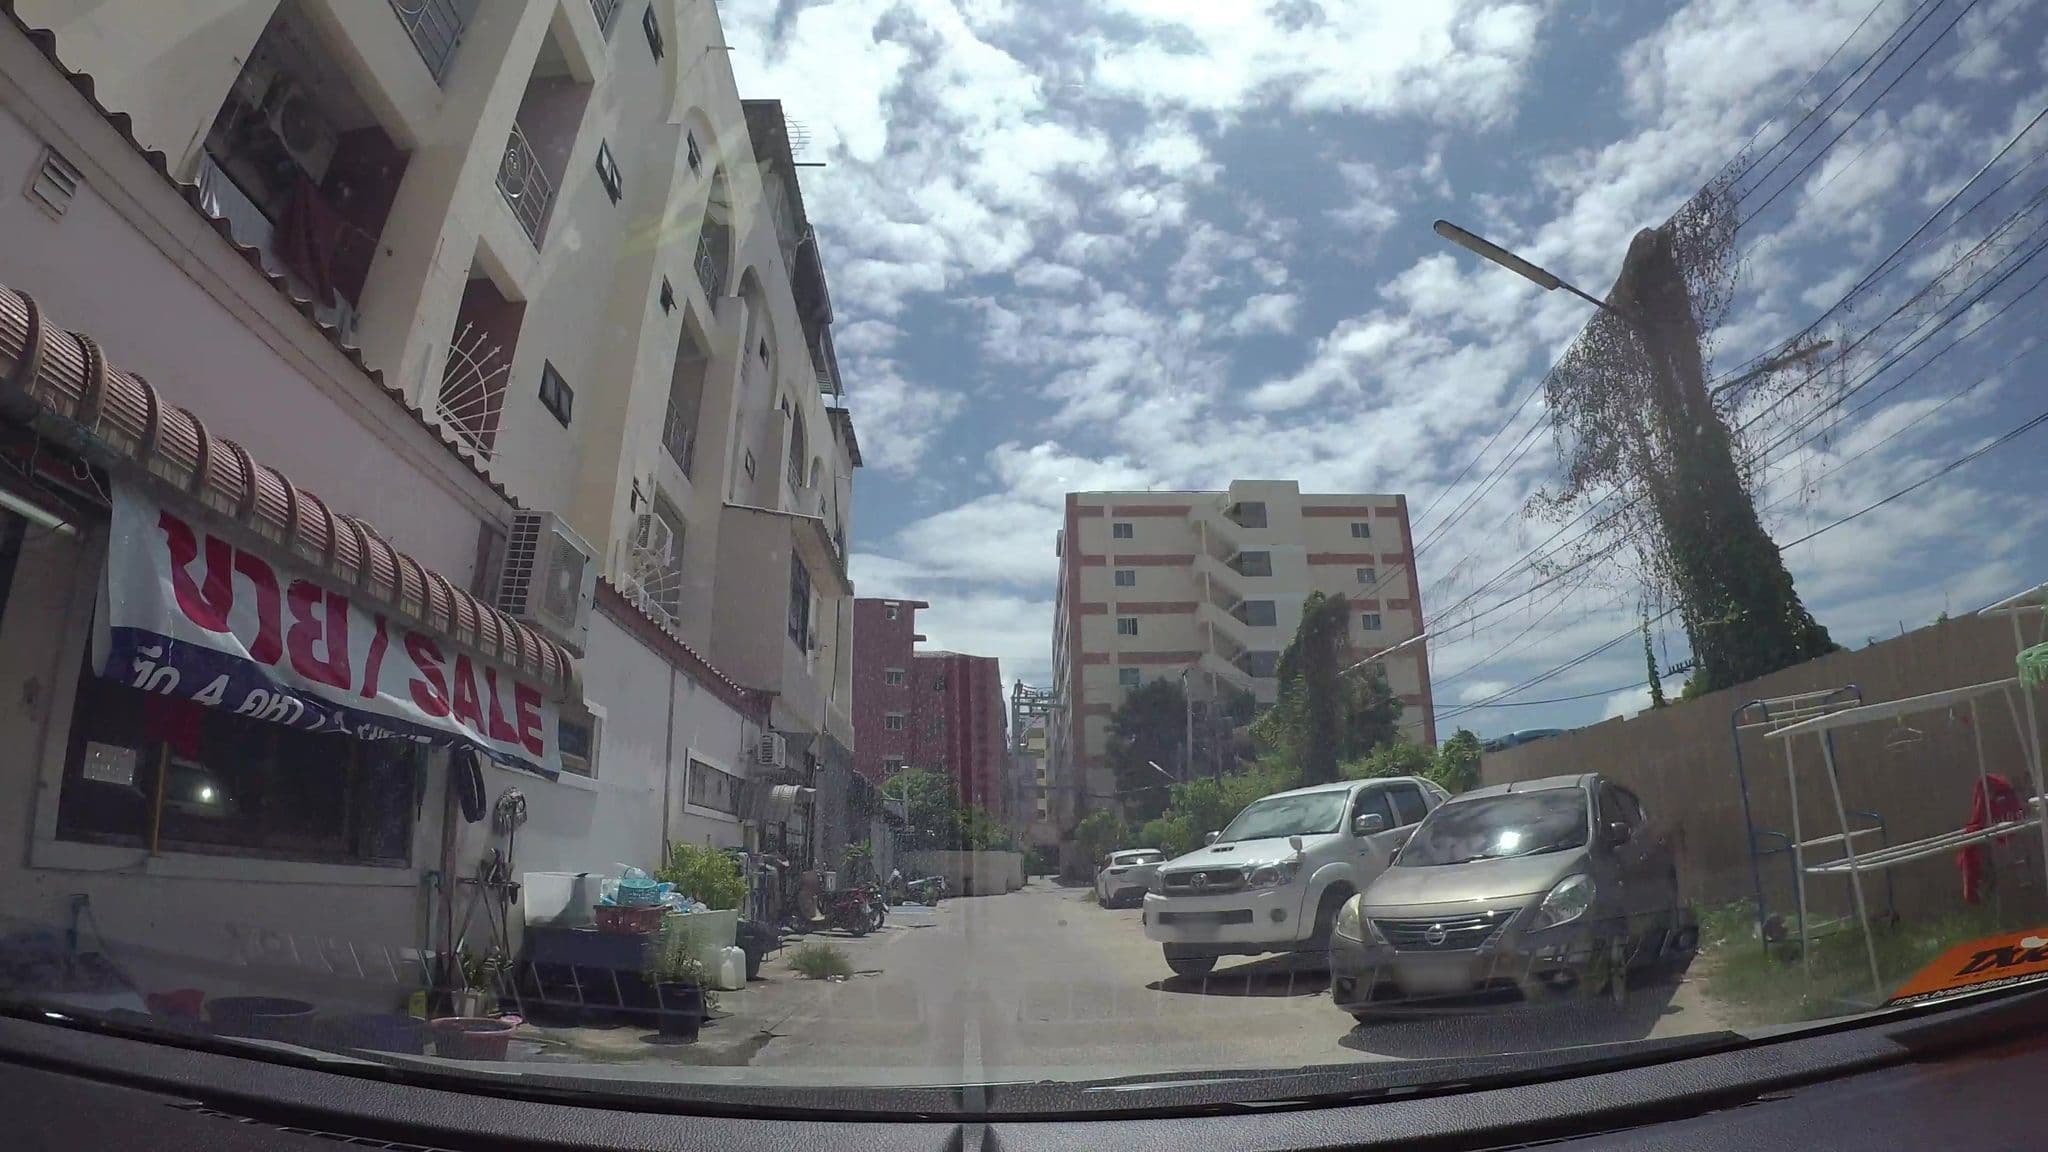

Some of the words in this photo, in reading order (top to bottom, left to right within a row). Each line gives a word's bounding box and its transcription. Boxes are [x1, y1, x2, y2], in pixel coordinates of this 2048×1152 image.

[159, 510, 351, 690] ขาย
[403, 631, 544, 757] SALE
[191, 674, 230, 706] 4
